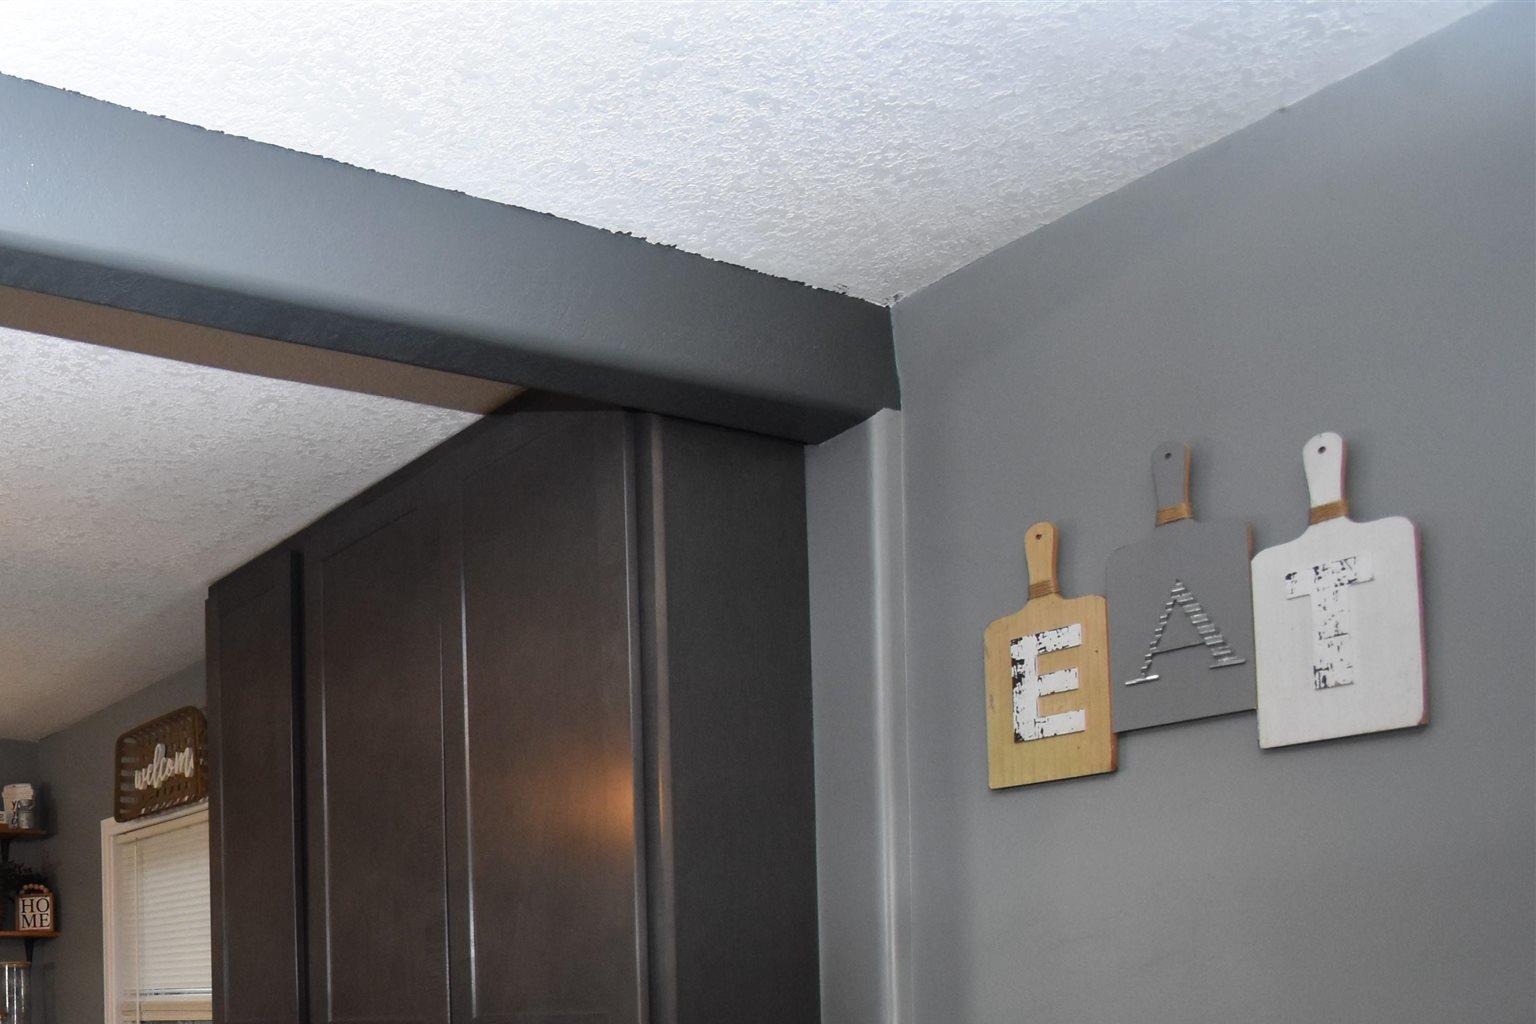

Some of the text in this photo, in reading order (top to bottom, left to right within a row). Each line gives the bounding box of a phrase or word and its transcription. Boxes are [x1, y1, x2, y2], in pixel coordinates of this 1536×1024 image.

[135, 743, 194, 790] welcom
[21, 898, 50, 913] HO
[21, 914, 50, 929] ME
